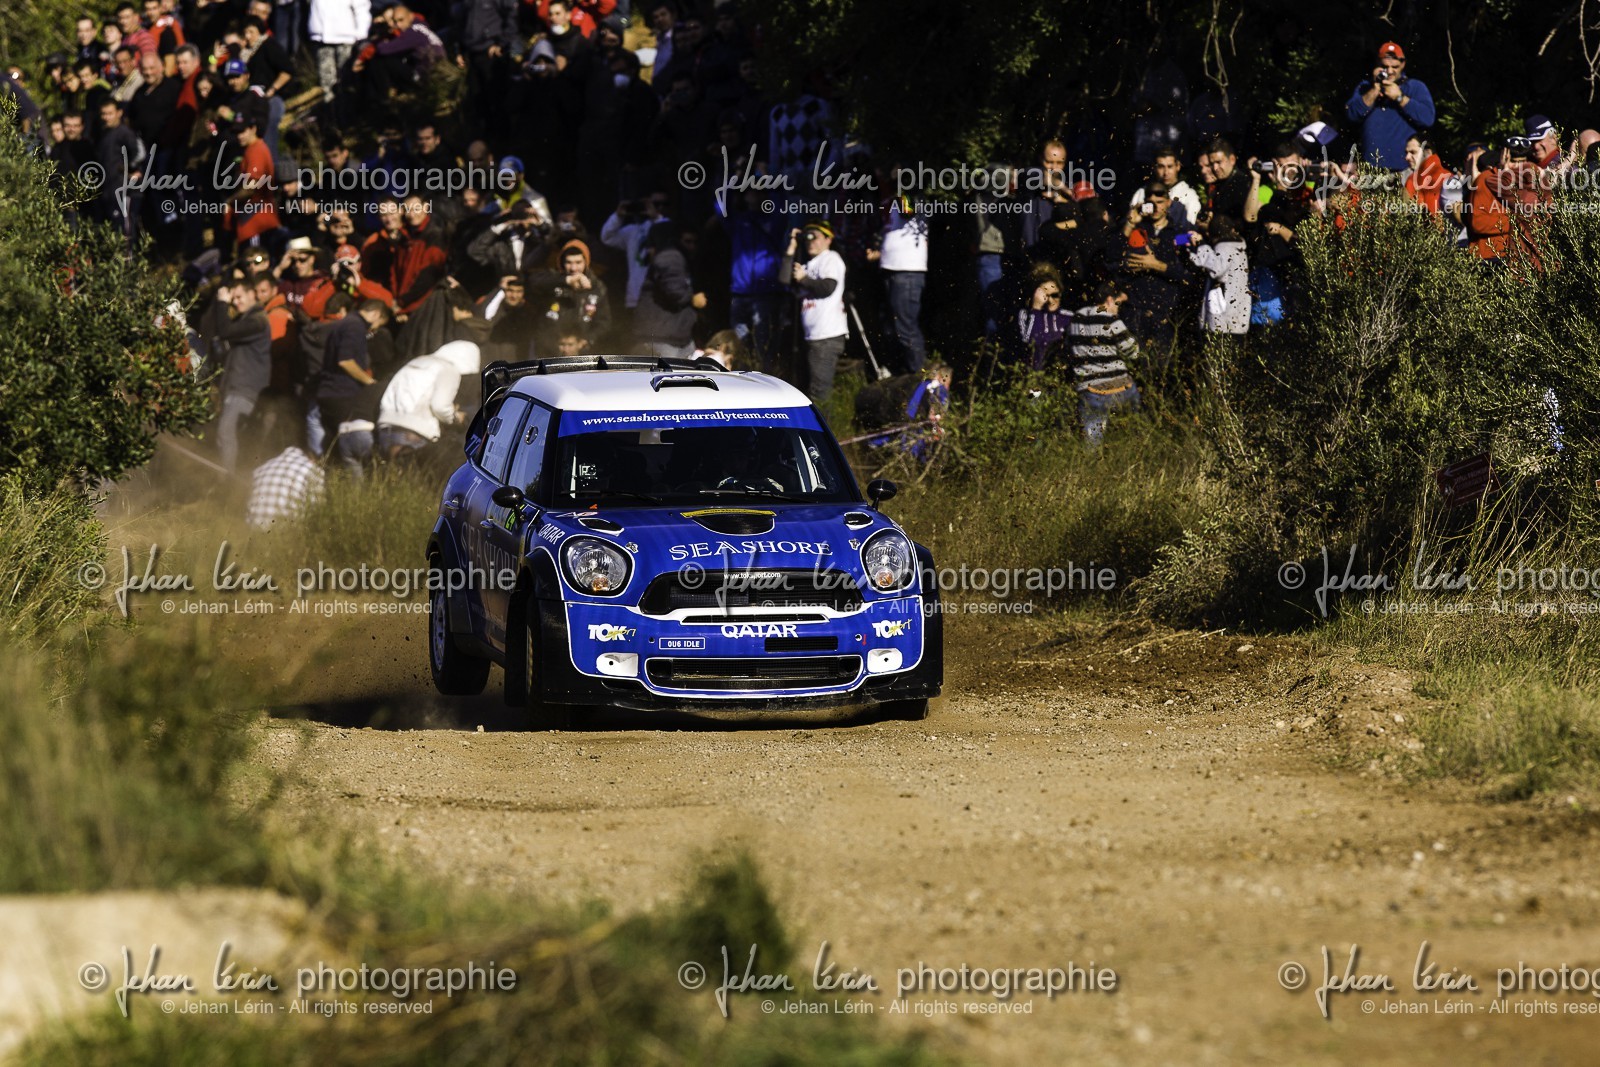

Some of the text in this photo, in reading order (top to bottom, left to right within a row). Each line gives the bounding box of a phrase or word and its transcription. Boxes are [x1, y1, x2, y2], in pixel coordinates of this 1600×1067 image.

[582, 411, 790, 426] www.seashoreqatarrallyteam.com
[538, 522, 566, 545] QATAR
[669, 540, 833, 561] SEASHORE
[720, 624, 798, 639] QATAR
